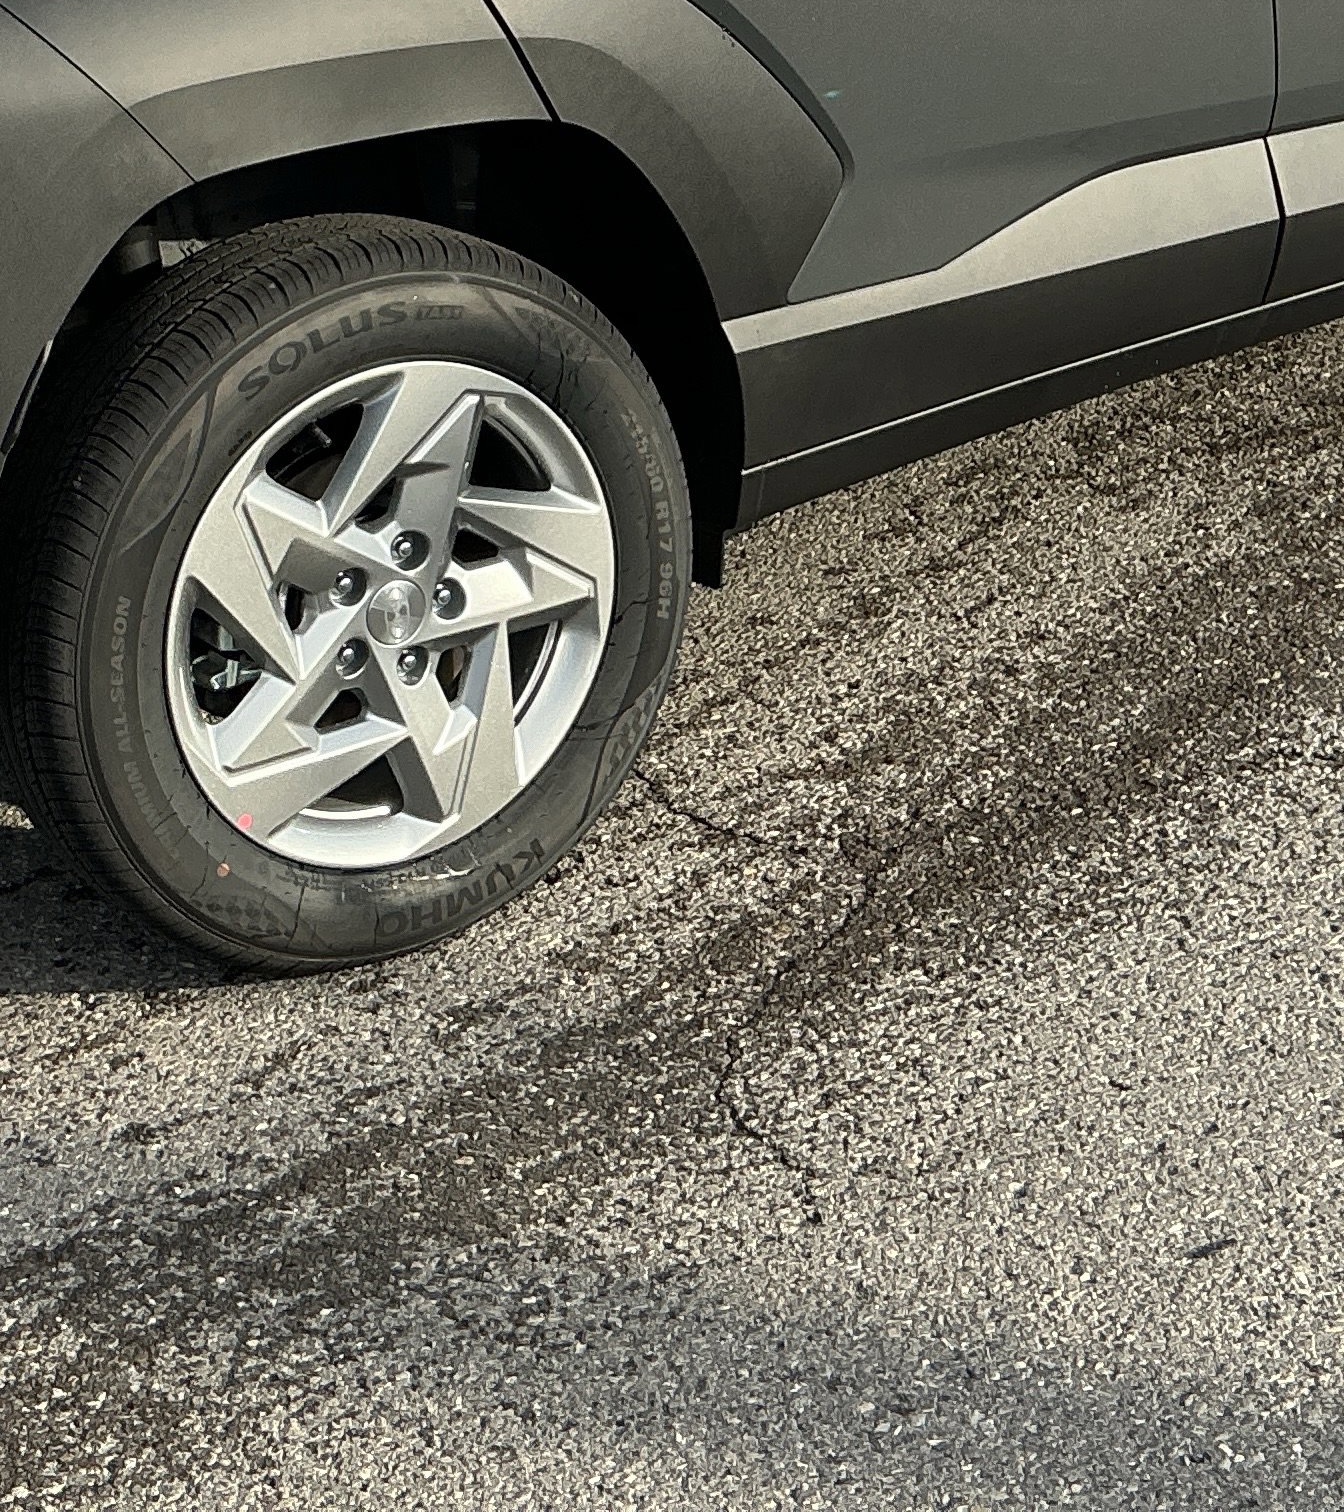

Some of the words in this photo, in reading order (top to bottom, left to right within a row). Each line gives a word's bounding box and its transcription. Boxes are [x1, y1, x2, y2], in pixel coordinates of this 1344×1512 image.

[237, 301, 409, 401] SOLUS
[109, 594, 134, 754] ALL-SEASON
[378, 838, 546, 936] KUMHO
